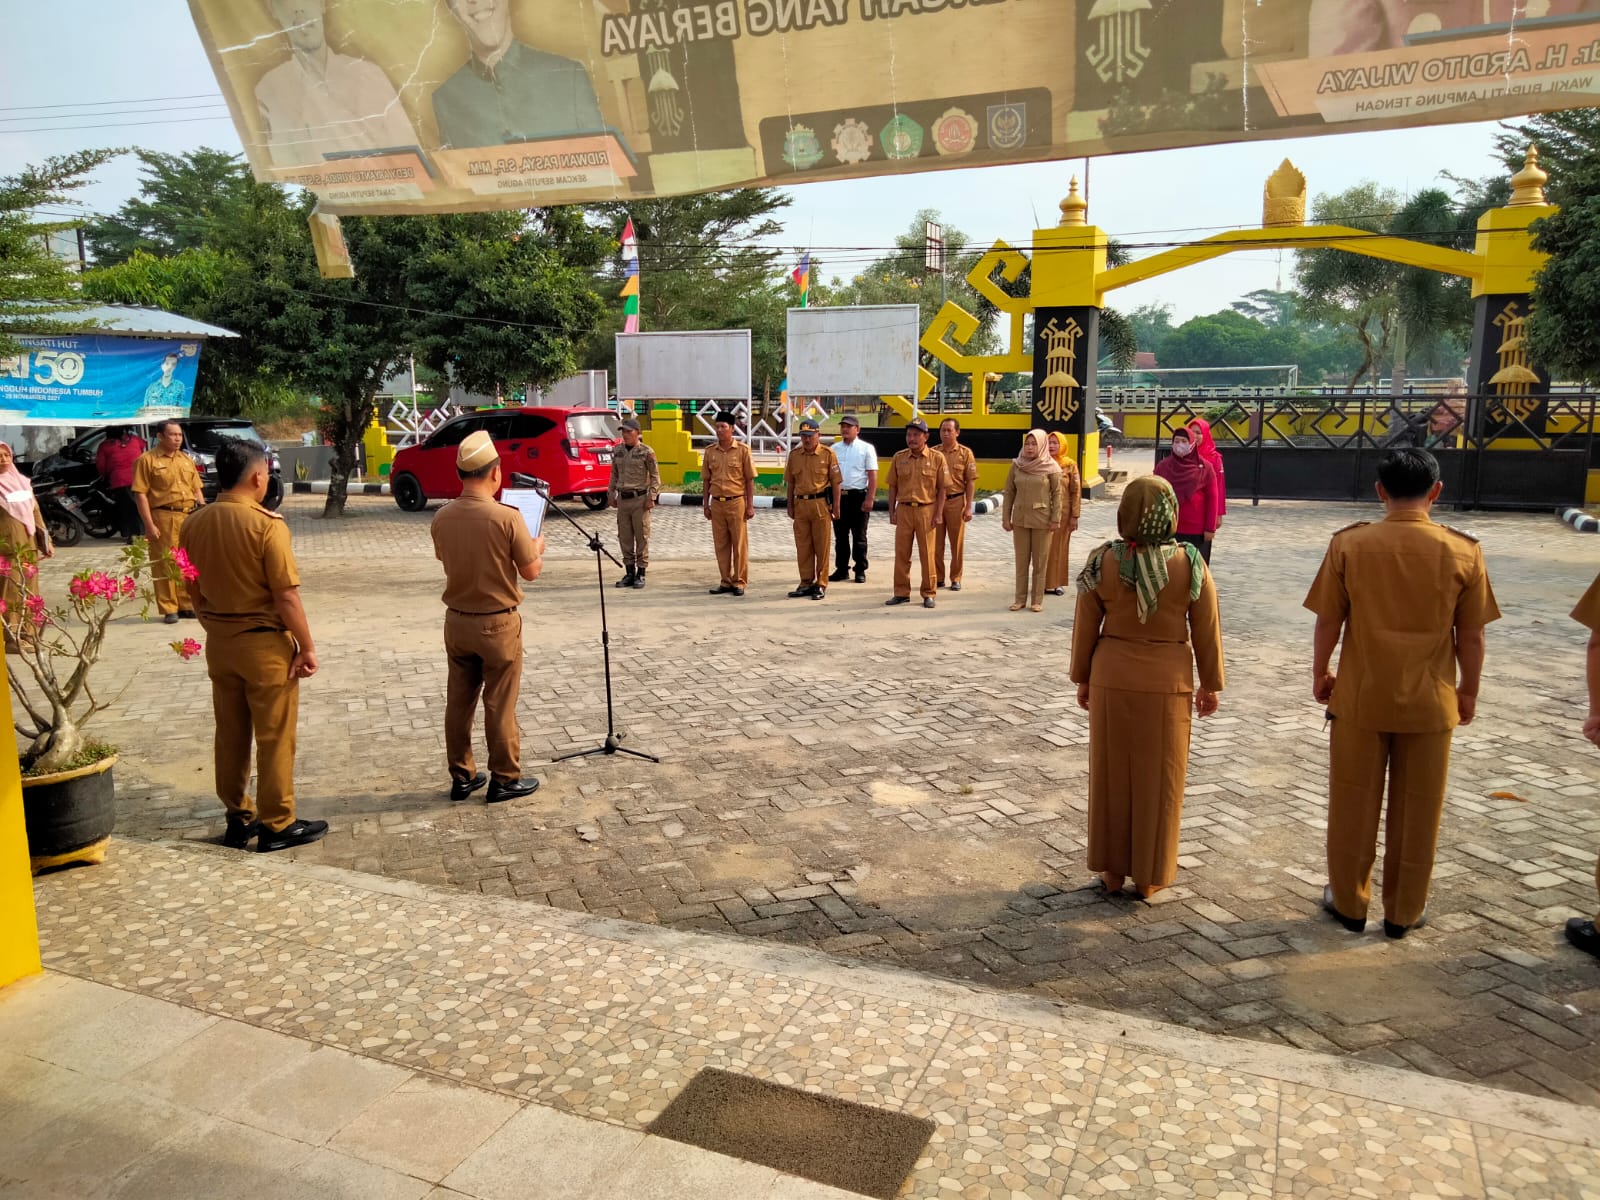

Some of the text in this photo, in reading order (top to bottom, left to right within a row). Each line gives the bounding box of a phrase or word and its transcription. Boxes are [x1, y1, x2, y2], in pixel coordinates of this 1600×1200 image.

[57, 341, 79, 349] HUT
[29, 386, 72, 396] INDONESIA
[72, 388, 104, 397] TUMBUH
